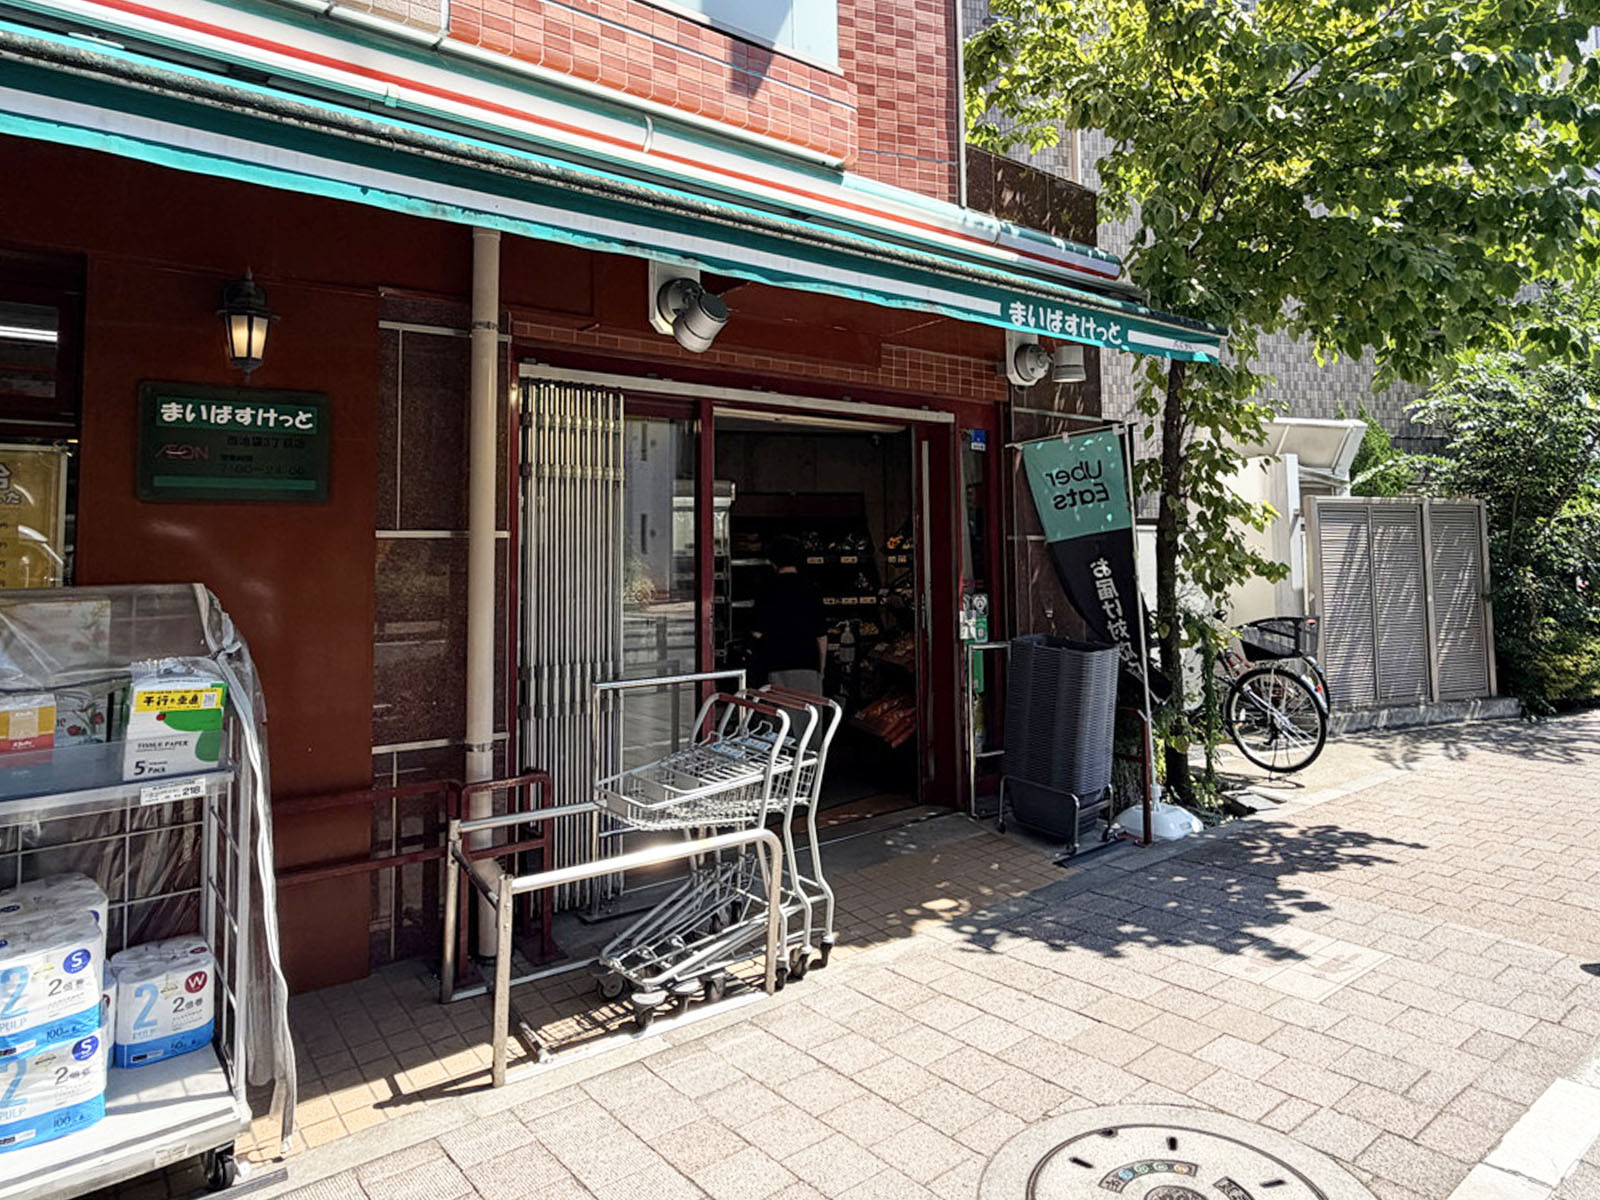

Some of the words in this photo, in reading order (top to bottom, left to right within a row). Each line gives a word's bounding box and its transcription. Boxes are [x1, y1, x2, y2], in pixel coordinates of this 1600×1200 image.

[1009, 301, 1122, 345] まいばすけっと
[160, 402, 314, 429] まいばすけっと
[134, 761, 146, 776] 5
[182, 785, 201, 796] 218
[71, 952, 82, 968] S
[187, 973, 205, 988] W
[0, 965, 29, 1018] 2
[133, 983, 158, 1030] 2
[0, 1017, 27, 1031] PULP
[81, 1039, 92, 1054] S
